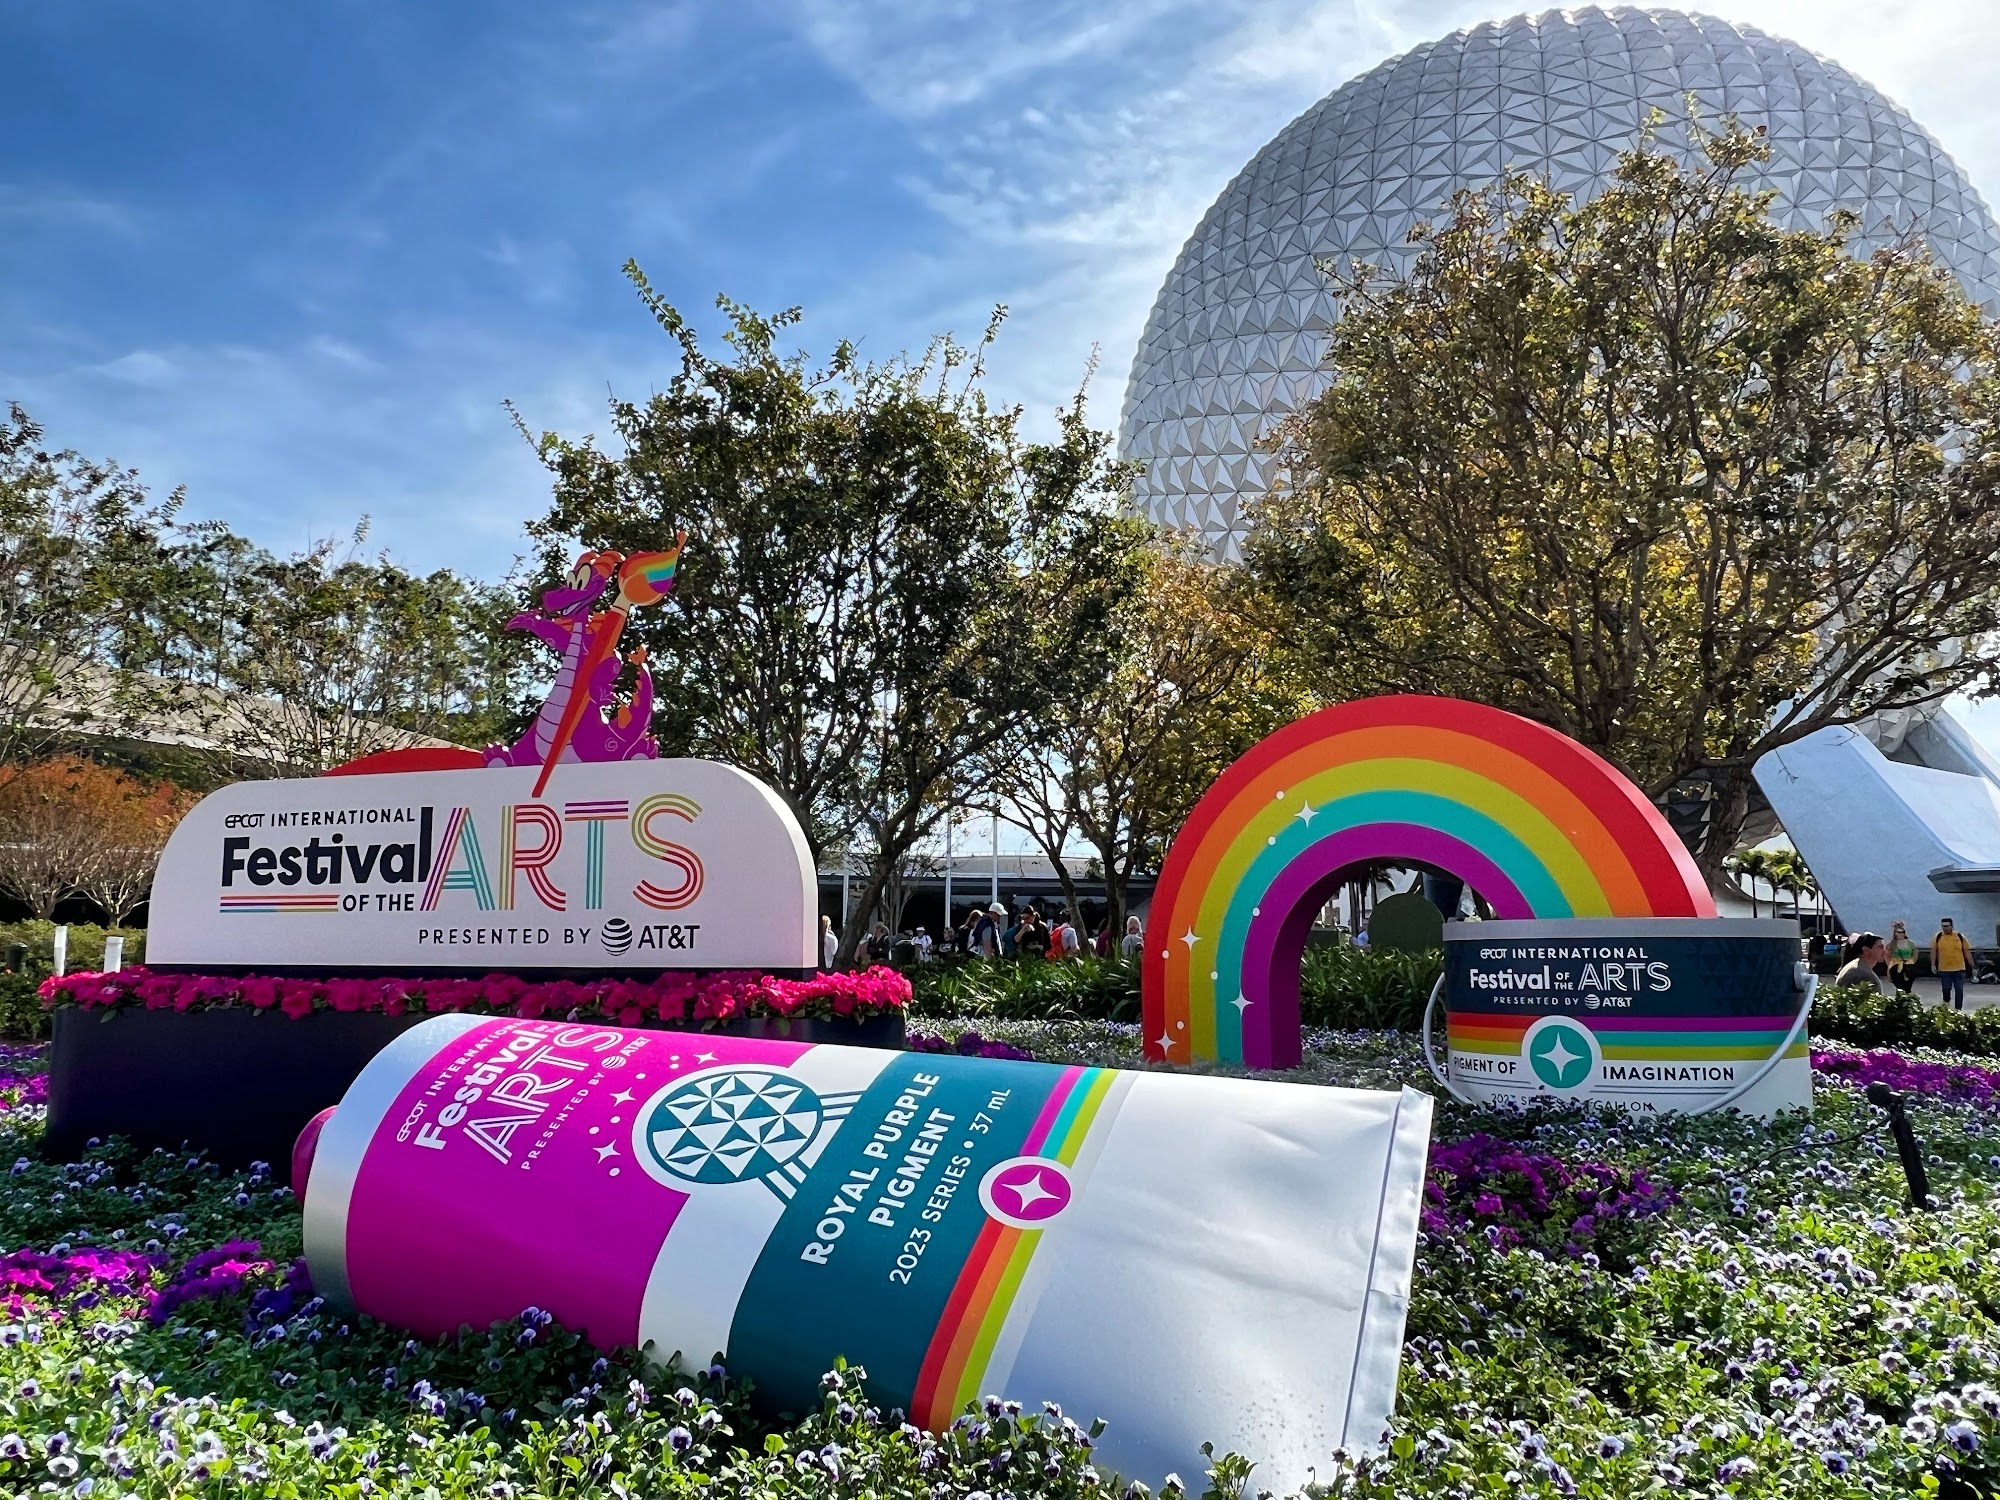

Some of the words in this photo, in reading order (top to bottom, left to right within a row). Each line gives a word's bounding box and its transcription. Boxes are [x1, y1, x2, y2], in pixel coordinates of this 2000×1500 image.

[225, 814, 265, 828] EPCOT
[271, 808, 416, 827] INTERNATIONAL
[221, 807, 433, 887] Festival
[342, 894, 369, 911] OF
[375, 894, 415, 911] THE
[419, 793, 704, 911] ARTS
[419, 928, 550, 944] PRESENTED
[564, 928, 592, 944] BY
[638, 925, 701, 949] AT&T
[1480, 949, 1507, 960] EPCOT
[1512, 947, 1649, 959] INTERNATIONAL
[1470, 965, 1550, 989] Festival
[1556, 972, 1570, 980] OF
[1578, 962, 1672, 992] ARTS
[1554, 982, 1574, 990] THE
[1493, 996, 1559, 1005] PRESENTED
[1564, 997, 1579, 1006] BY
[1602, 997, 1632, 1007] AT&T
[414, 1029, 549, 1150] Festival
[1454, 1056, 1494, 1073] PIGMENT
[1498, 1061, 1517, 1075] OF
[1602, 1066, 1735, 1081] IMAGINATION
[463, 1027, 624, 1165] ARTS
[521, 1089, 589, 1170] PRESENTED
[588, 1072, 605, 1086] BY
[619, 1035, 652, 1057] AT&T
[1491, 1093, 1516, 1105] 202
[397, 1100, 428, 1142] EPCOT
[801, 1166, 880, 1265] ROYAL
[863, 1072, 941, 1160] PURPLE
[868, 1107, 956, 1227] PIGMENT
[889, 1227, 932, 1285] 2023
[922, 1155, 971, 1223] SERIES
[969, 1111, 993, 1135] 37
[988, 1088, 1011, 1111] mL
